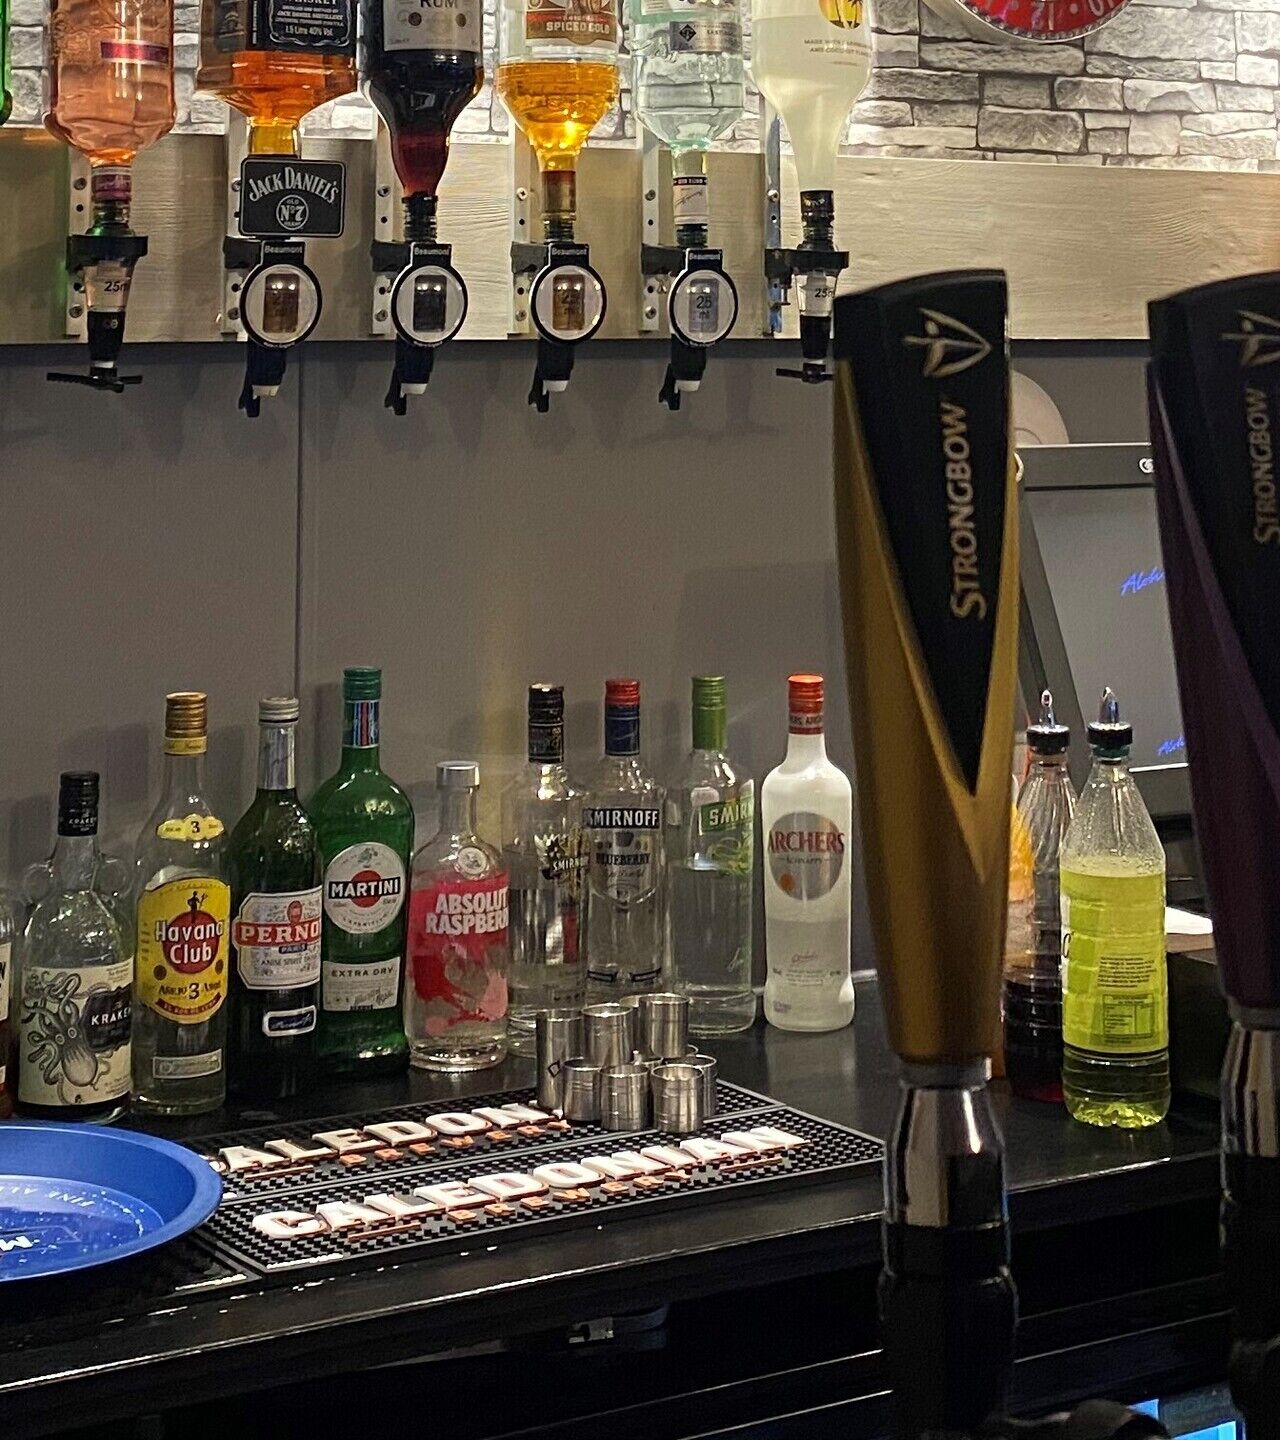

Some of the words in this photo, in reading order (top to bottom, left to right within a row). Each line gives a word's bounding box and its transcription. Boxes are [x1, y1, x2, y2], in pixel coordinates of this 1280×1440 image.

[546, 21, 588, 33] SPICED
[249, 172, 284, 202] JACK
[284, 166, 339, 205] DANIEL'S
[264, 245, 303, 254] Beaumont
[414, 247, 450, 257] Beaumont
[552, 247, 589, 256] Beaumont
[696, 294, 712, 310] 25
[938, 400, 988, 622] STRONGBOW
[190, 820, 201, 835] 3
[588, 809, 659, 828] SMIRNOFF
[330, 878, 400, 898] MARTINI
[435, 885, 509, 915] ABSOLUT
[154, 918, 224, 944] Havana
[169, 942, 213, 965] Club
[331, 967, 369, 978] EXTRA
[372, 966, 394, 977] DRY
[188, 981, 200, 1000] 3
[250, 1125, 812, 1240] CALEDONIAN
[43, 1189, 97, 1208] FINE
